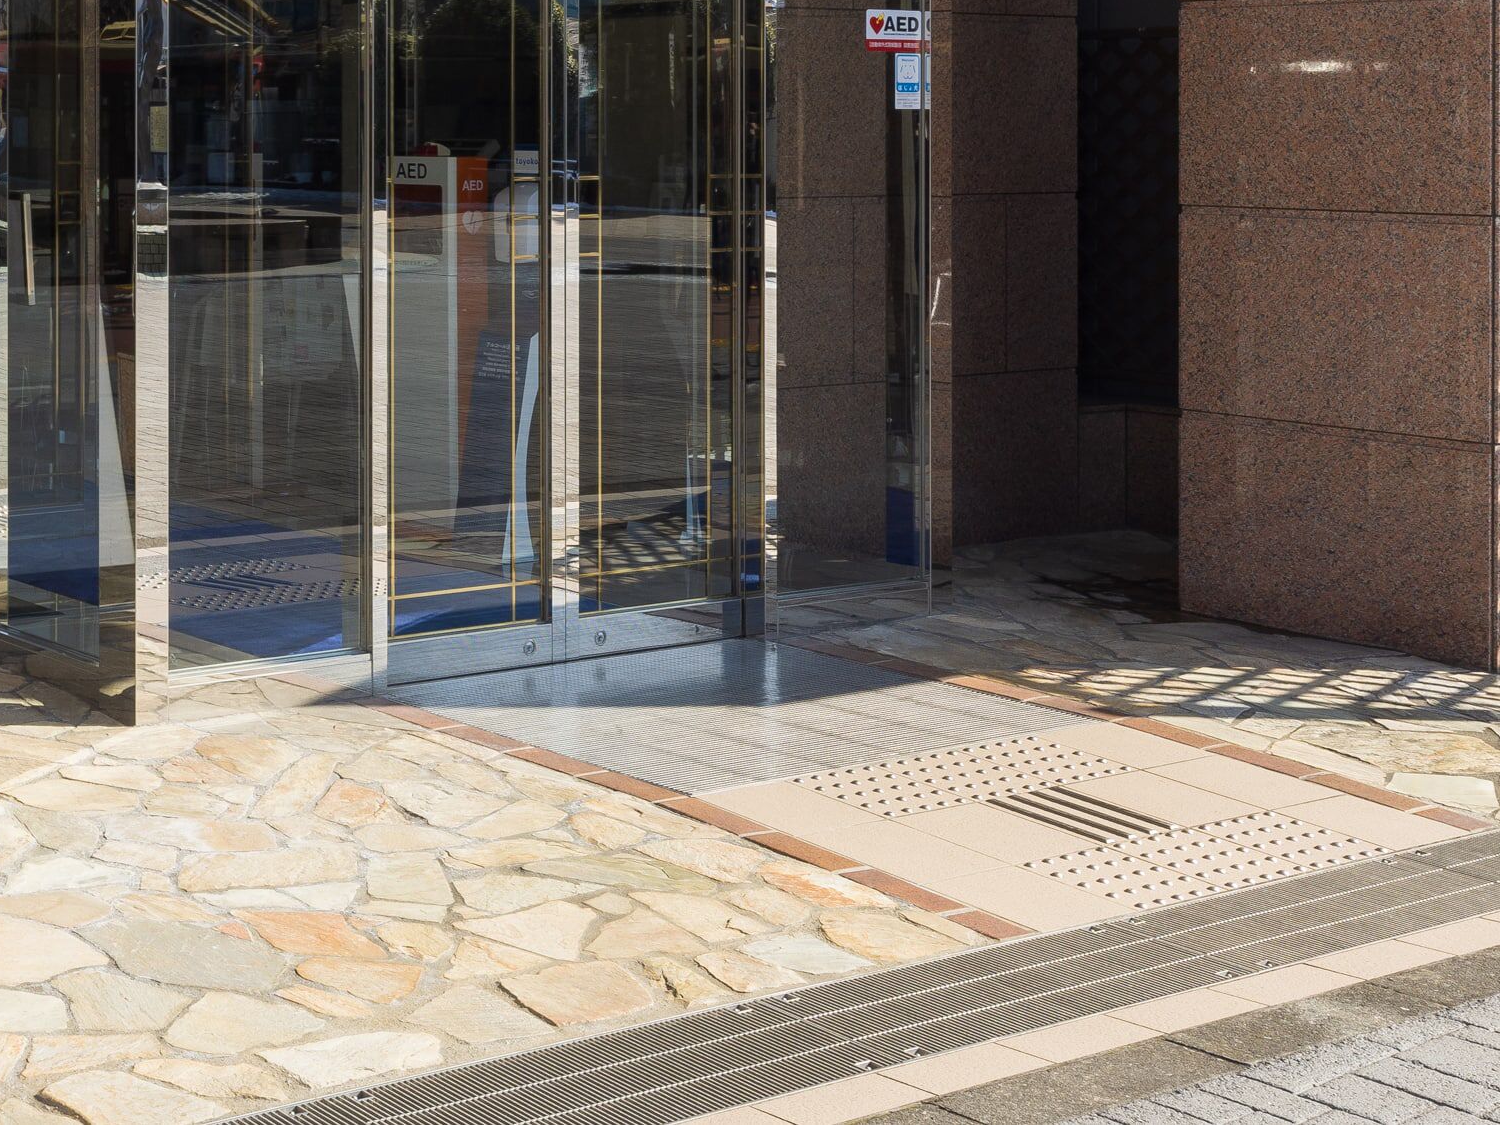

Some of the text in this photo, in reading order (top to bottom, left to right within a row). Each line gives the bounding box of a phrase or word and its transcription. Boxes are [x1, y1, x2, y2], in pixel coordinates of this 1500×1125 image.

[884, 16, 919, 32] AED
[396, 163, 427, 179] AED
[462, 180, 484, 191] AED
